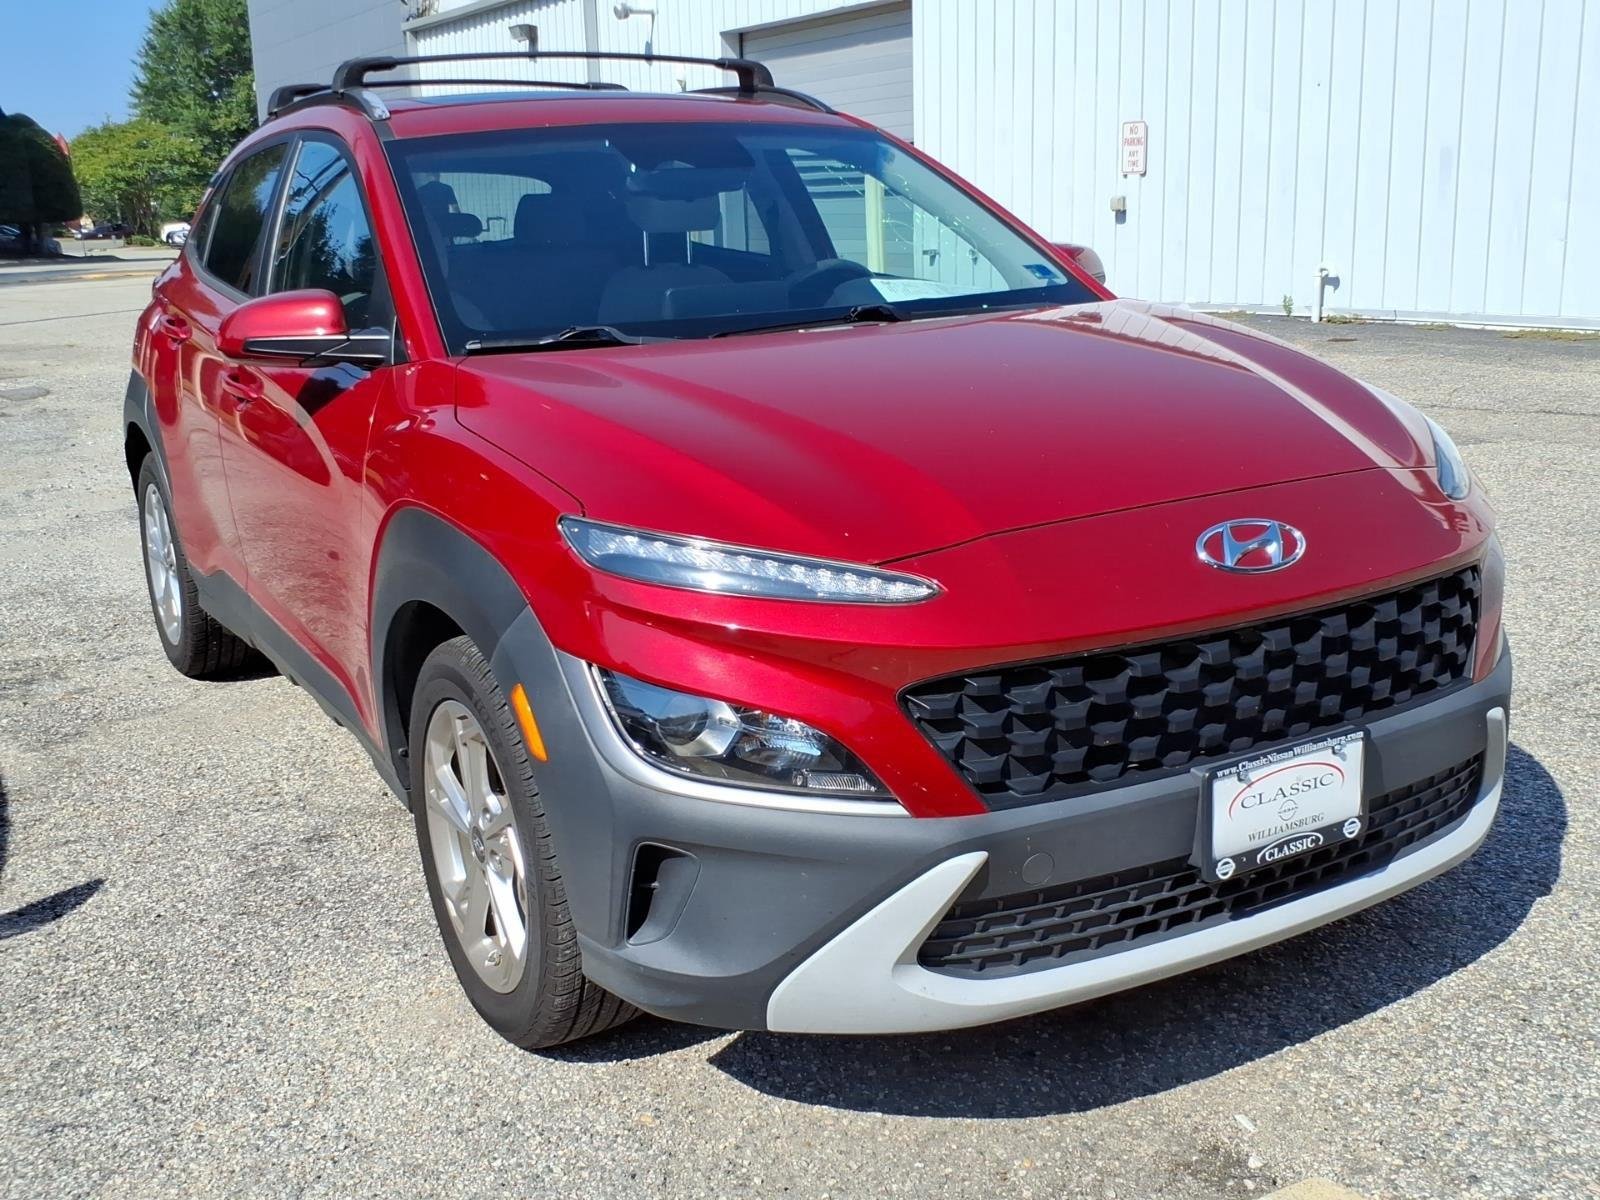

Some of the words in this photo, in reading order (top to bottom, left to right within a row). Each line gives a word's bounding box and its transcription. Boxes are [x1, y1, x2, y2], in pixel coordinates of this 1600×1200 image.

[1129, 125, 1139, 135] NO
[1123, 137, 1144, 146] PARKING
[1128, 150, 1139, 158] ANY
[1127, 160, 1140, 168] TIME
[1216, 731, 1364, 778] www.ClassicNissanWilliamsburg.com
[1240, 773, 1335, 809] CLASSIC
[1248, 812, 1325, 843] WILLIAMSBURG
[1265, 835, 1318, 862] CLASSIC
